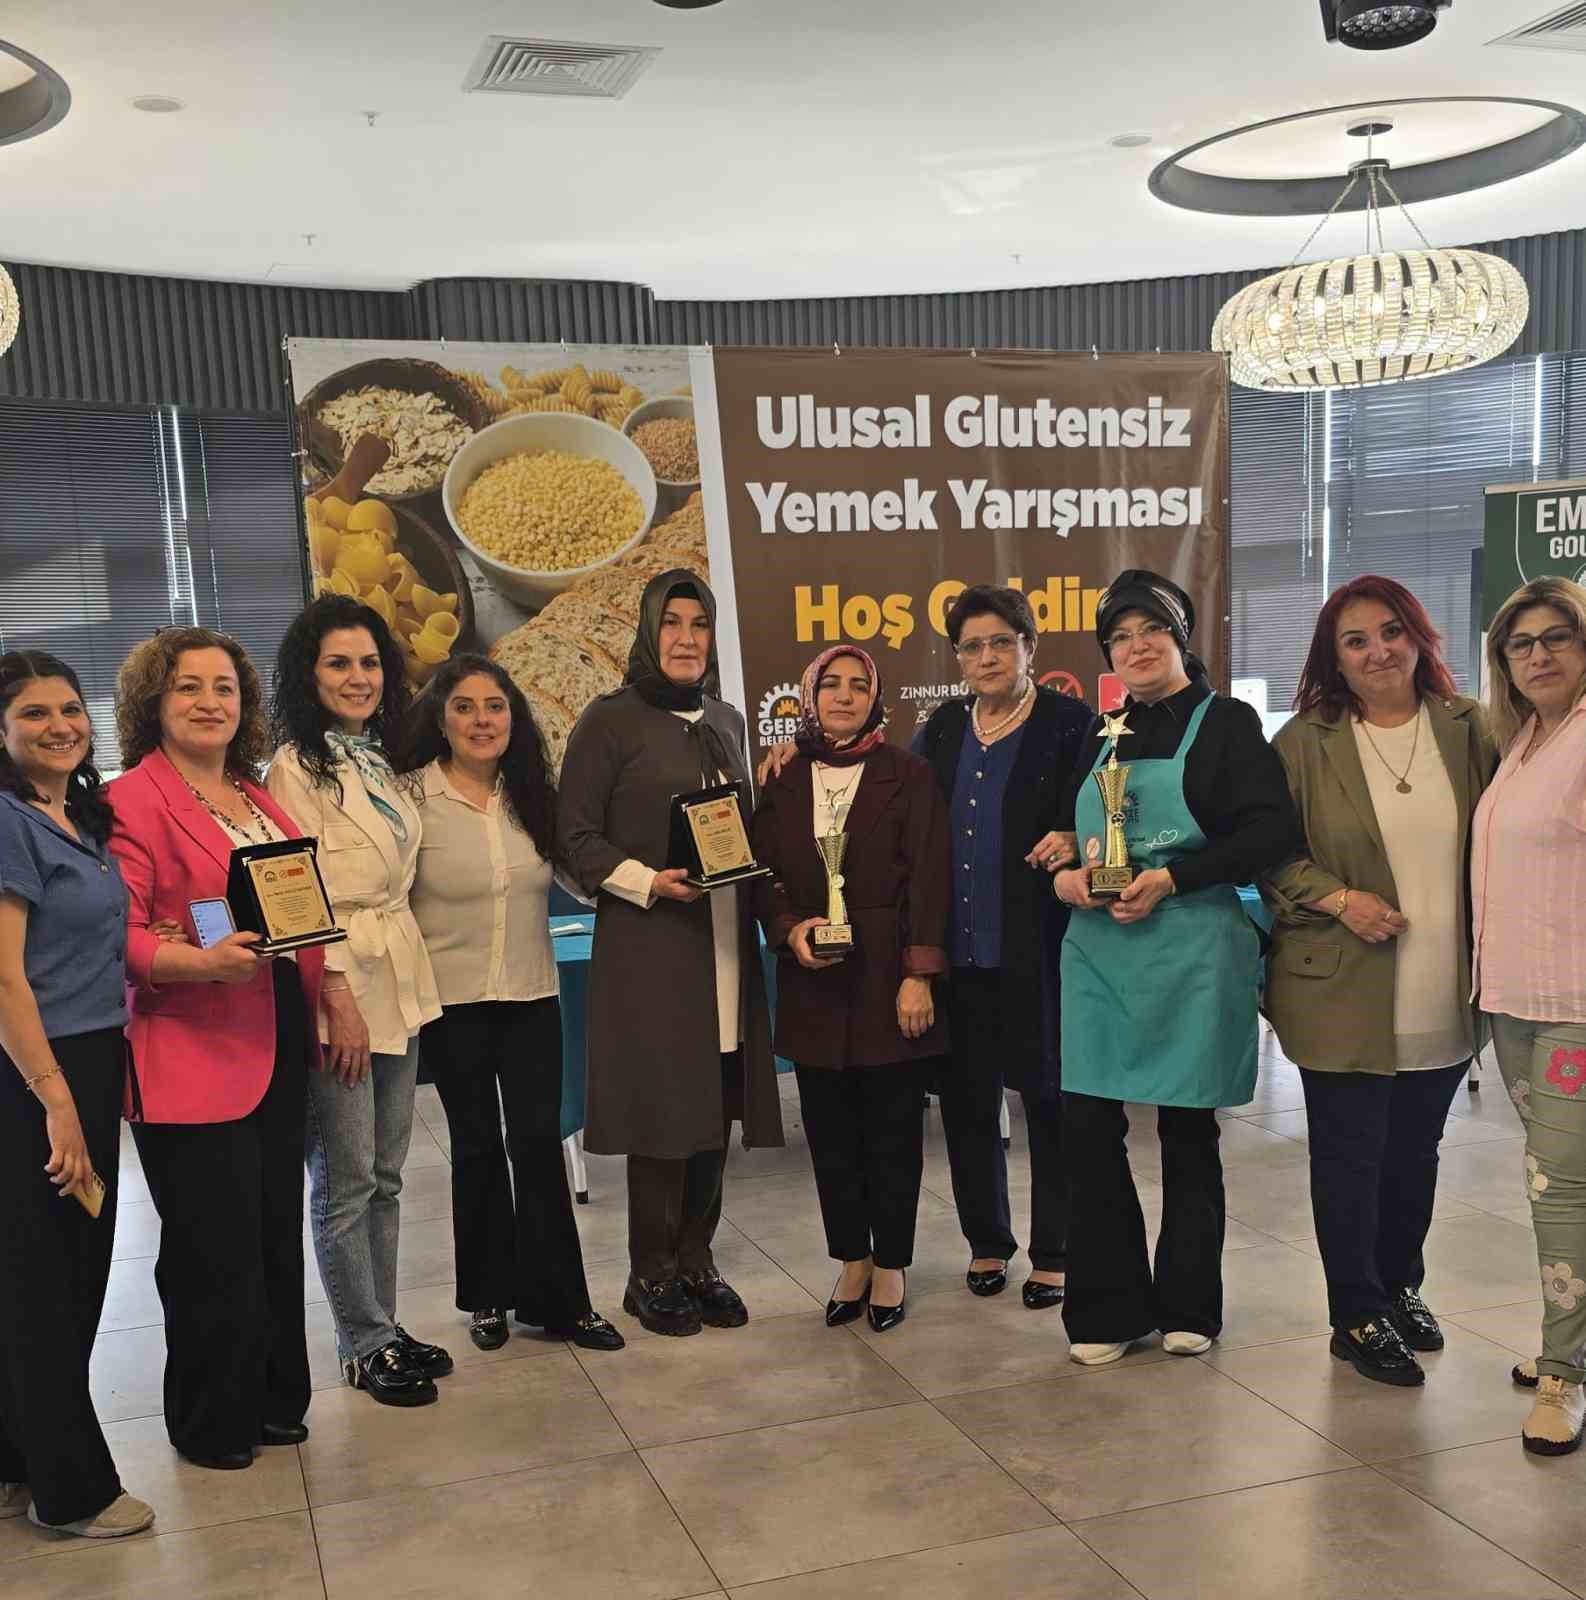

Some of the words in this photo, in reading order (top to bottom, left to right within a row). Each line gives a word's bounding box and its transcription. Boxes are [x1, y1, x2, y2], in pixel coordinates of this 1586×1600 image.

[756, 394, 931, 449] Ulusal
[944, 394, 1192, 448] Glutensiz
[745, 478, 939, 534] Yemek
[947, 479, 1202, 538] Yarışması
[795, 584, 914, 650] Hoş
[758, 717, 802, 736] GEB
